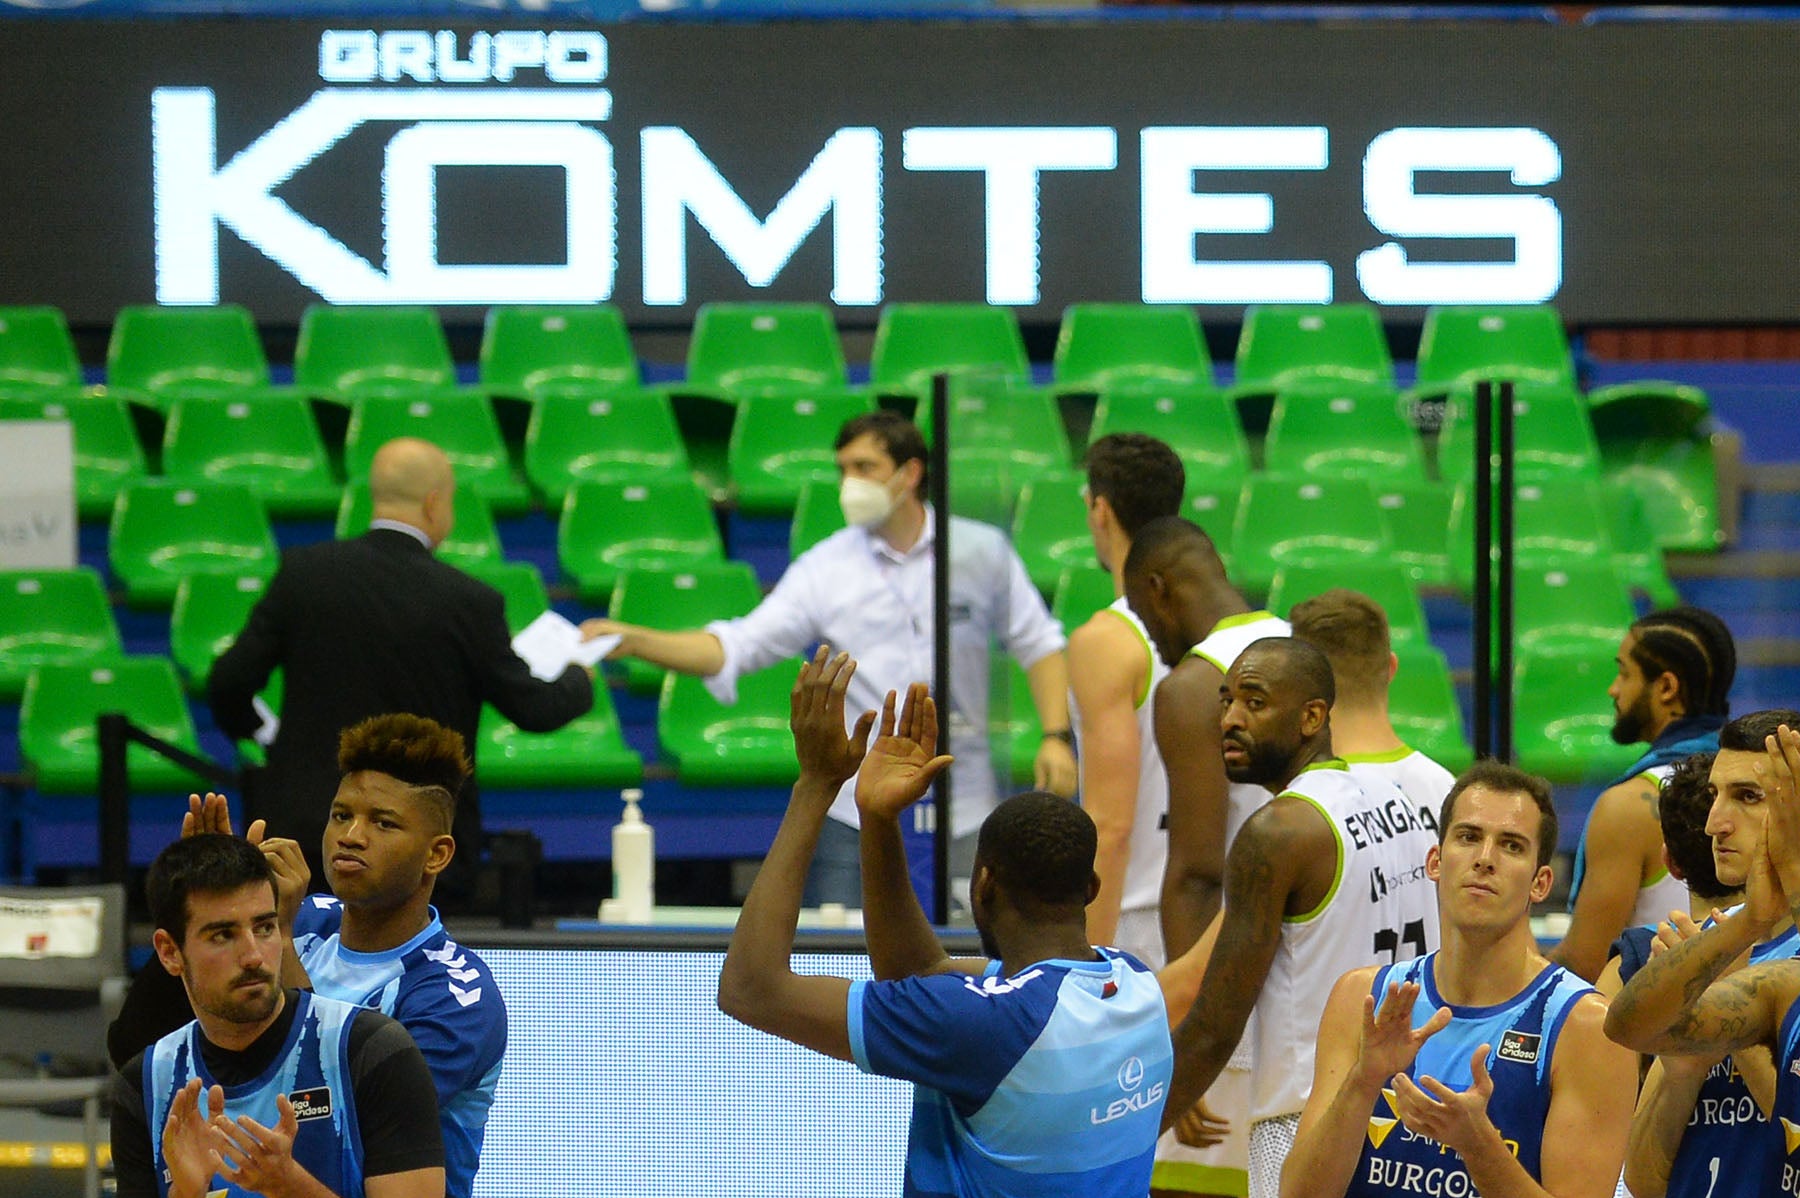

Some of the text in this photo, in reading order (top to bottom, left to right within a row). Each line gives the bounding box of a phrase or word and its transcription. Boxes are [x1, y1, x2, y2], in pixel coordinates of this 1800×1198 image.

[318, 30, 607, 82] GRUPO
[152, 87, 1563, 305] KOMTES
[1090, 1082, 1163, 1126] LEXUS
